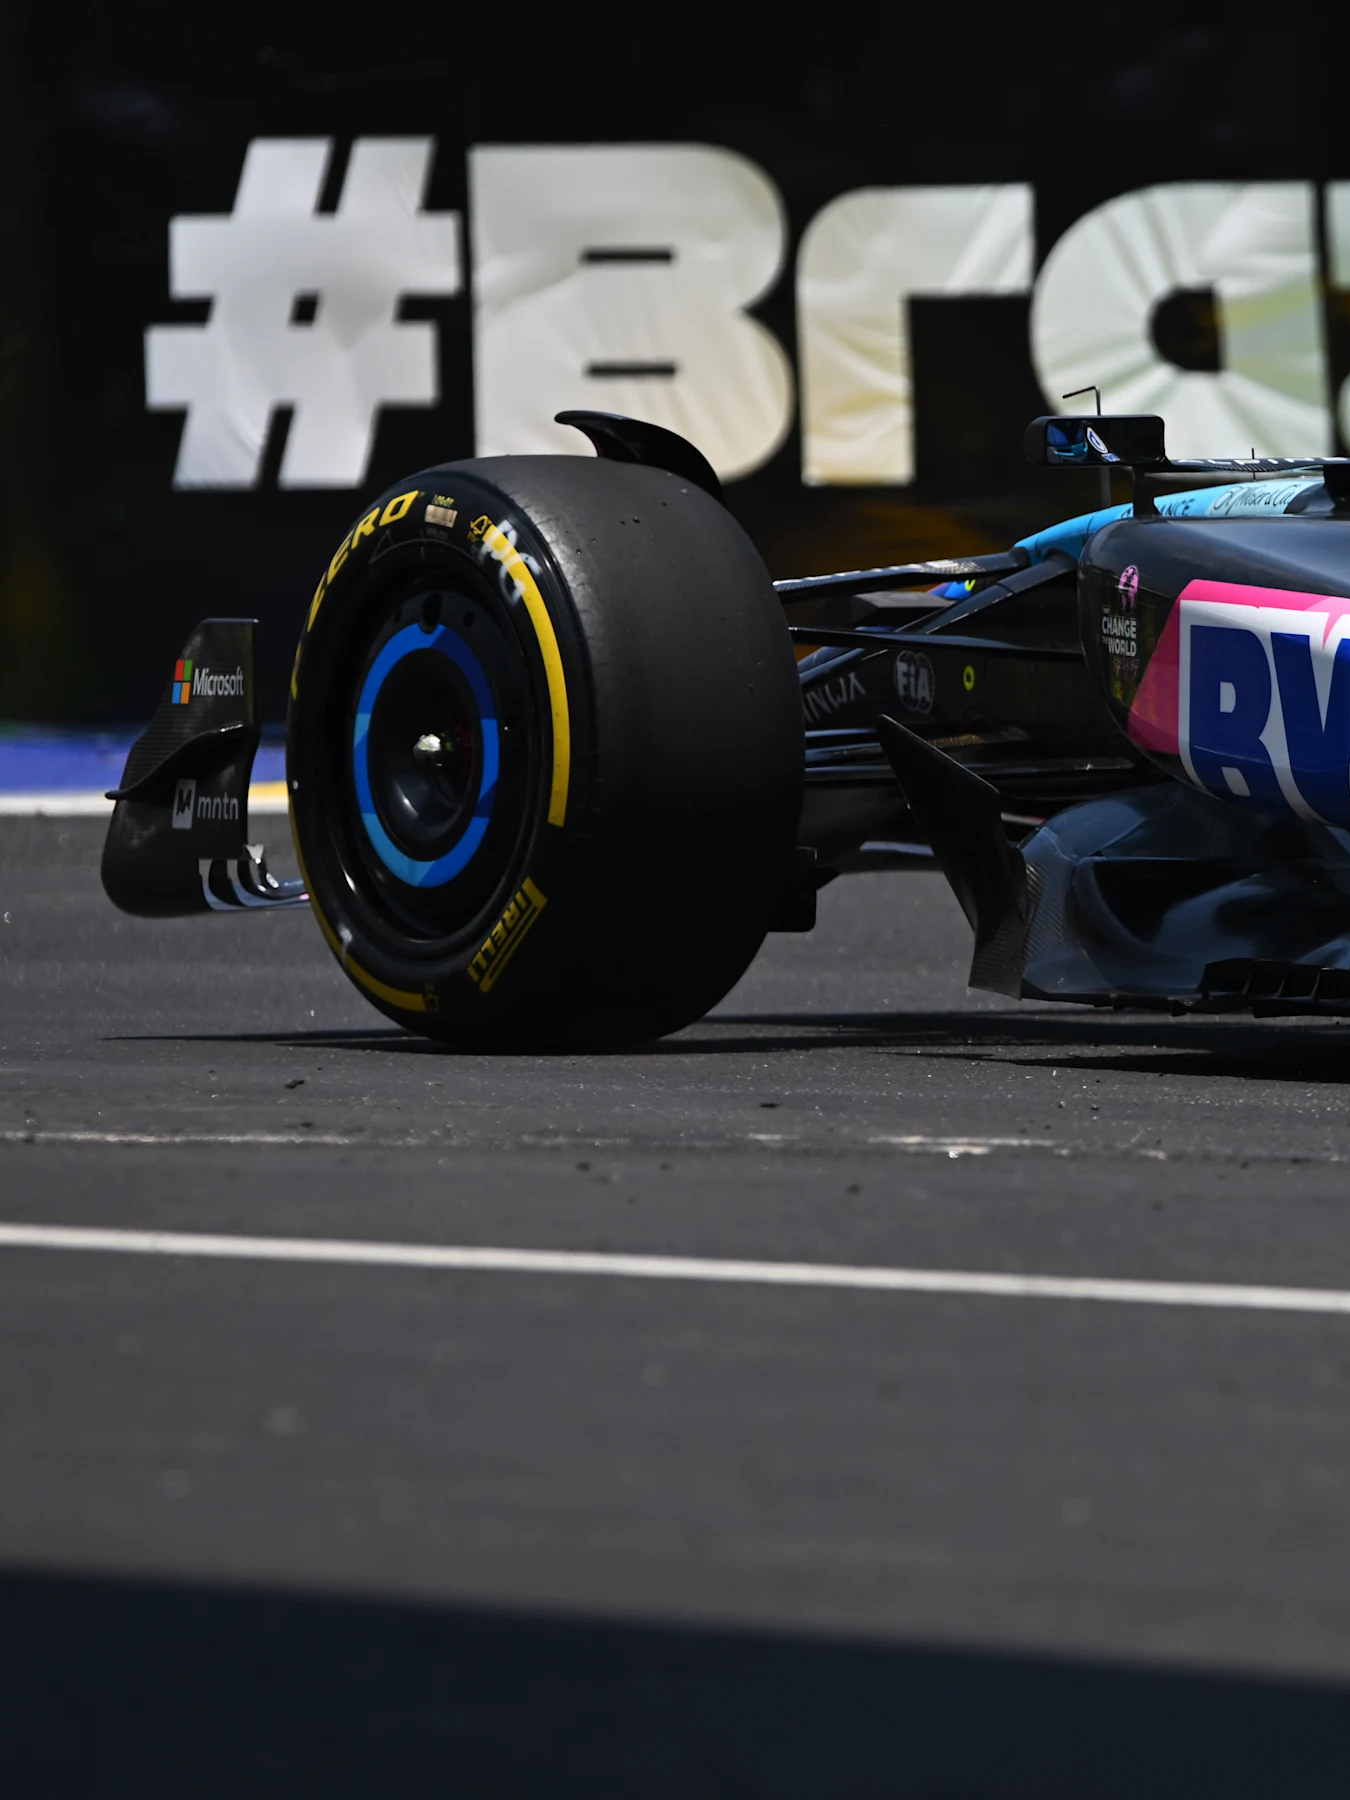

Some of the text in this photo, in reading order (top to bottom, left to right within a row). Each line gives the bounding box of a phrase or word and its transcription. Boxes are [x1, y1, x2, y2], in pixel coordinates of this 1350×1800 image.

[1101, 616, 1137, 639] CHANGE
[1108, 638, 1137, 657] WORLD
[193, 666, 244, 696] Microsoft
[197, 792, 239, 821] mntn
[467, 876, 548, 993] PIRELLI
